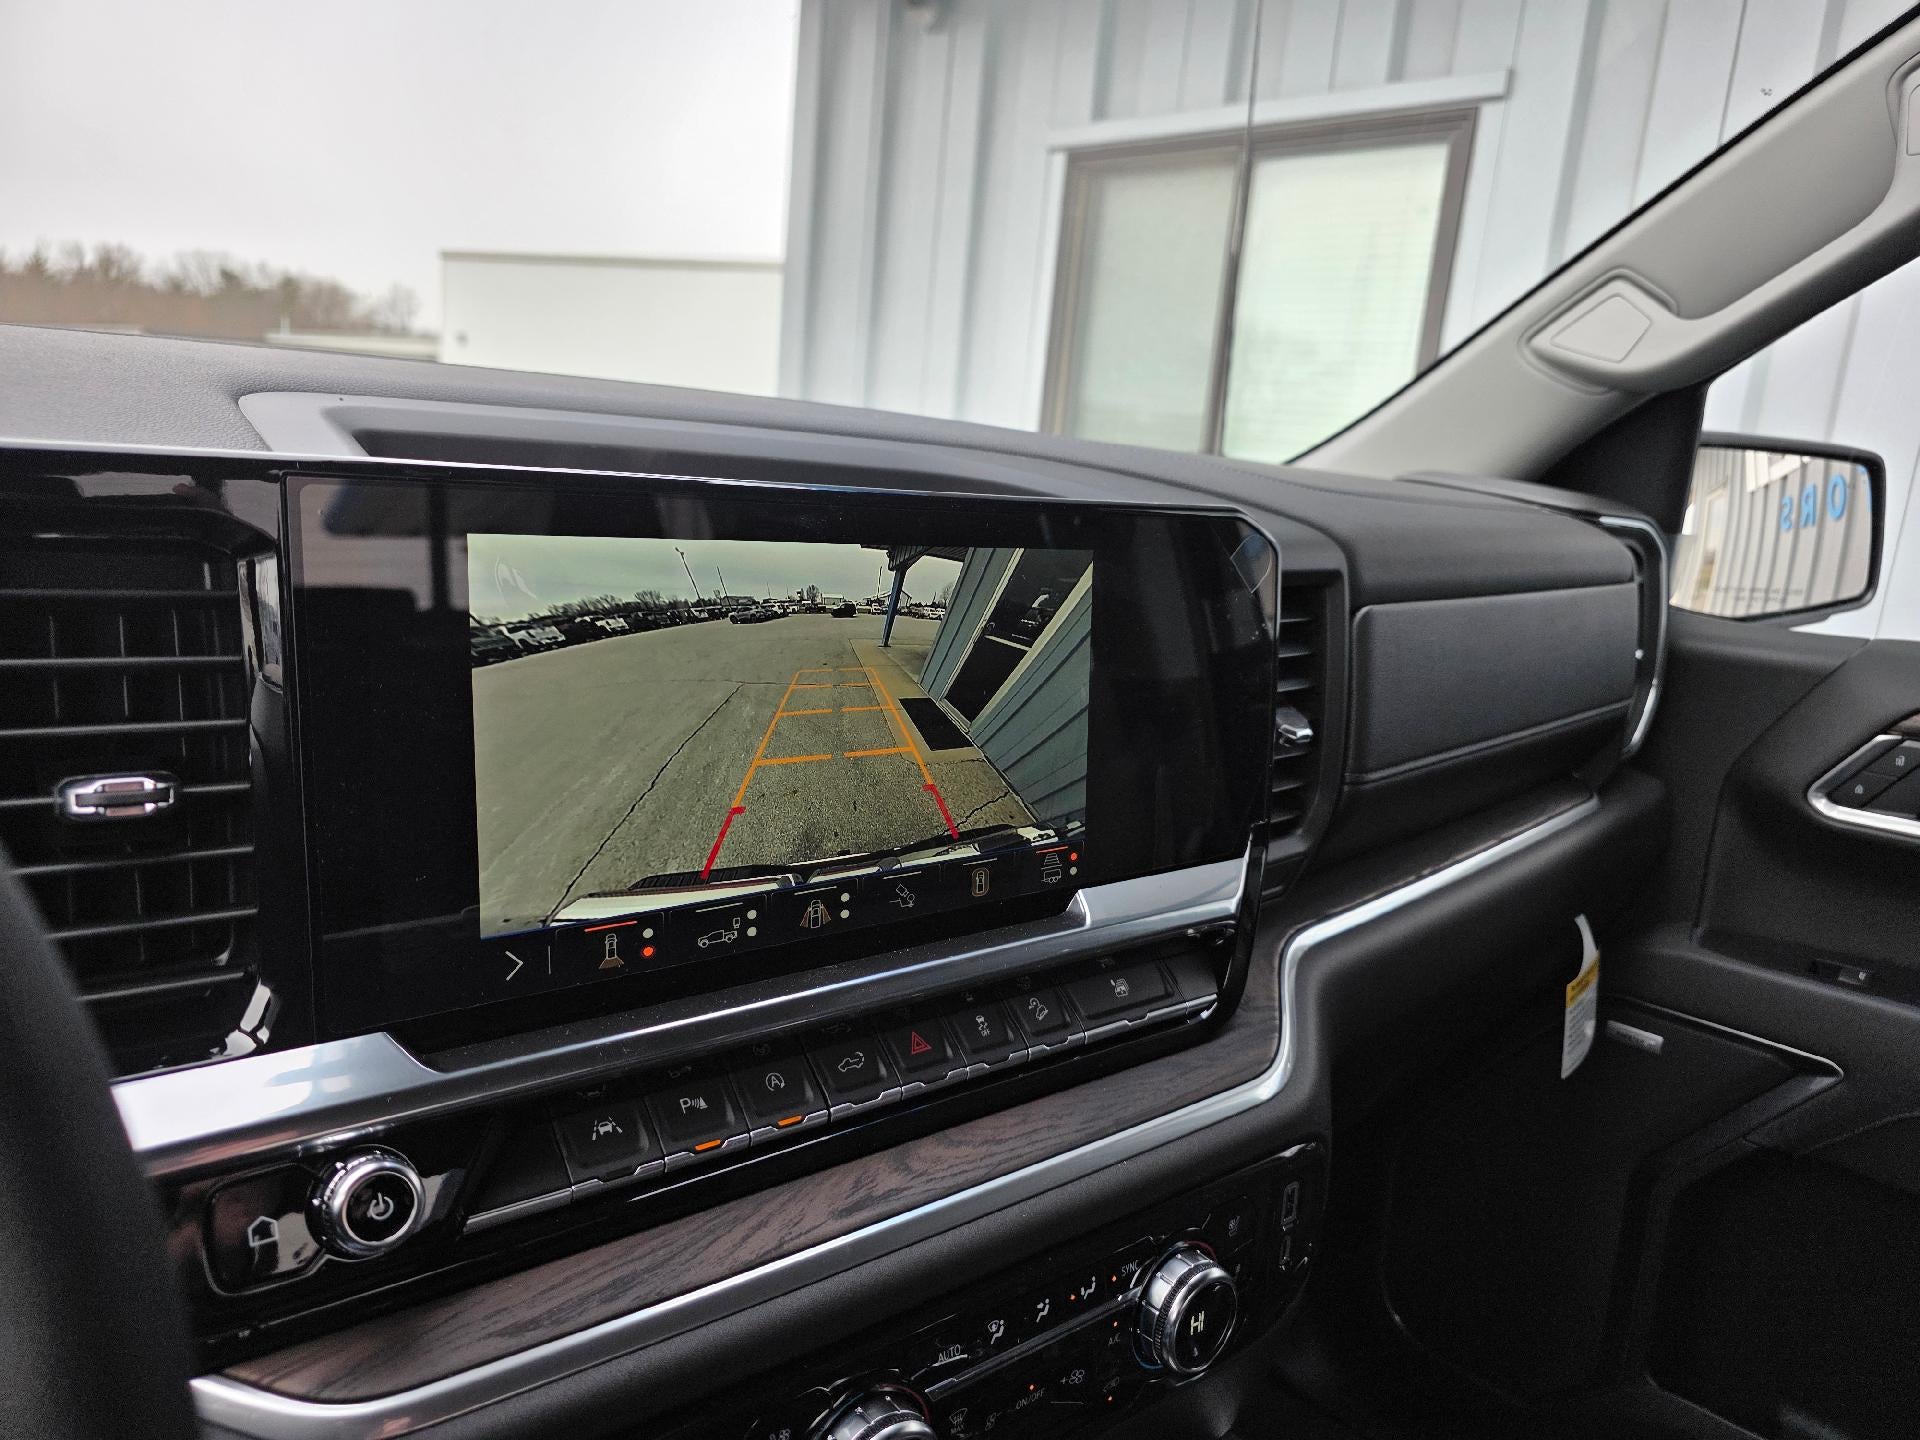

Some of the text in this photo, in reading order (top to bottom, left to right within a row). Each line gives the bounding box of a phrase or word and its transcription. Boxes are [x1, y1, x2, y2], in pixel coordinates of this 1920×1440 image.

[1121, 1259, 1140, 1277] SYNC
[1190, 1310, 1205, 1336] HI
[937, 1344, 961, 1363] AUTO
[1016, 1387, 1045, 1410] ON/OFF
